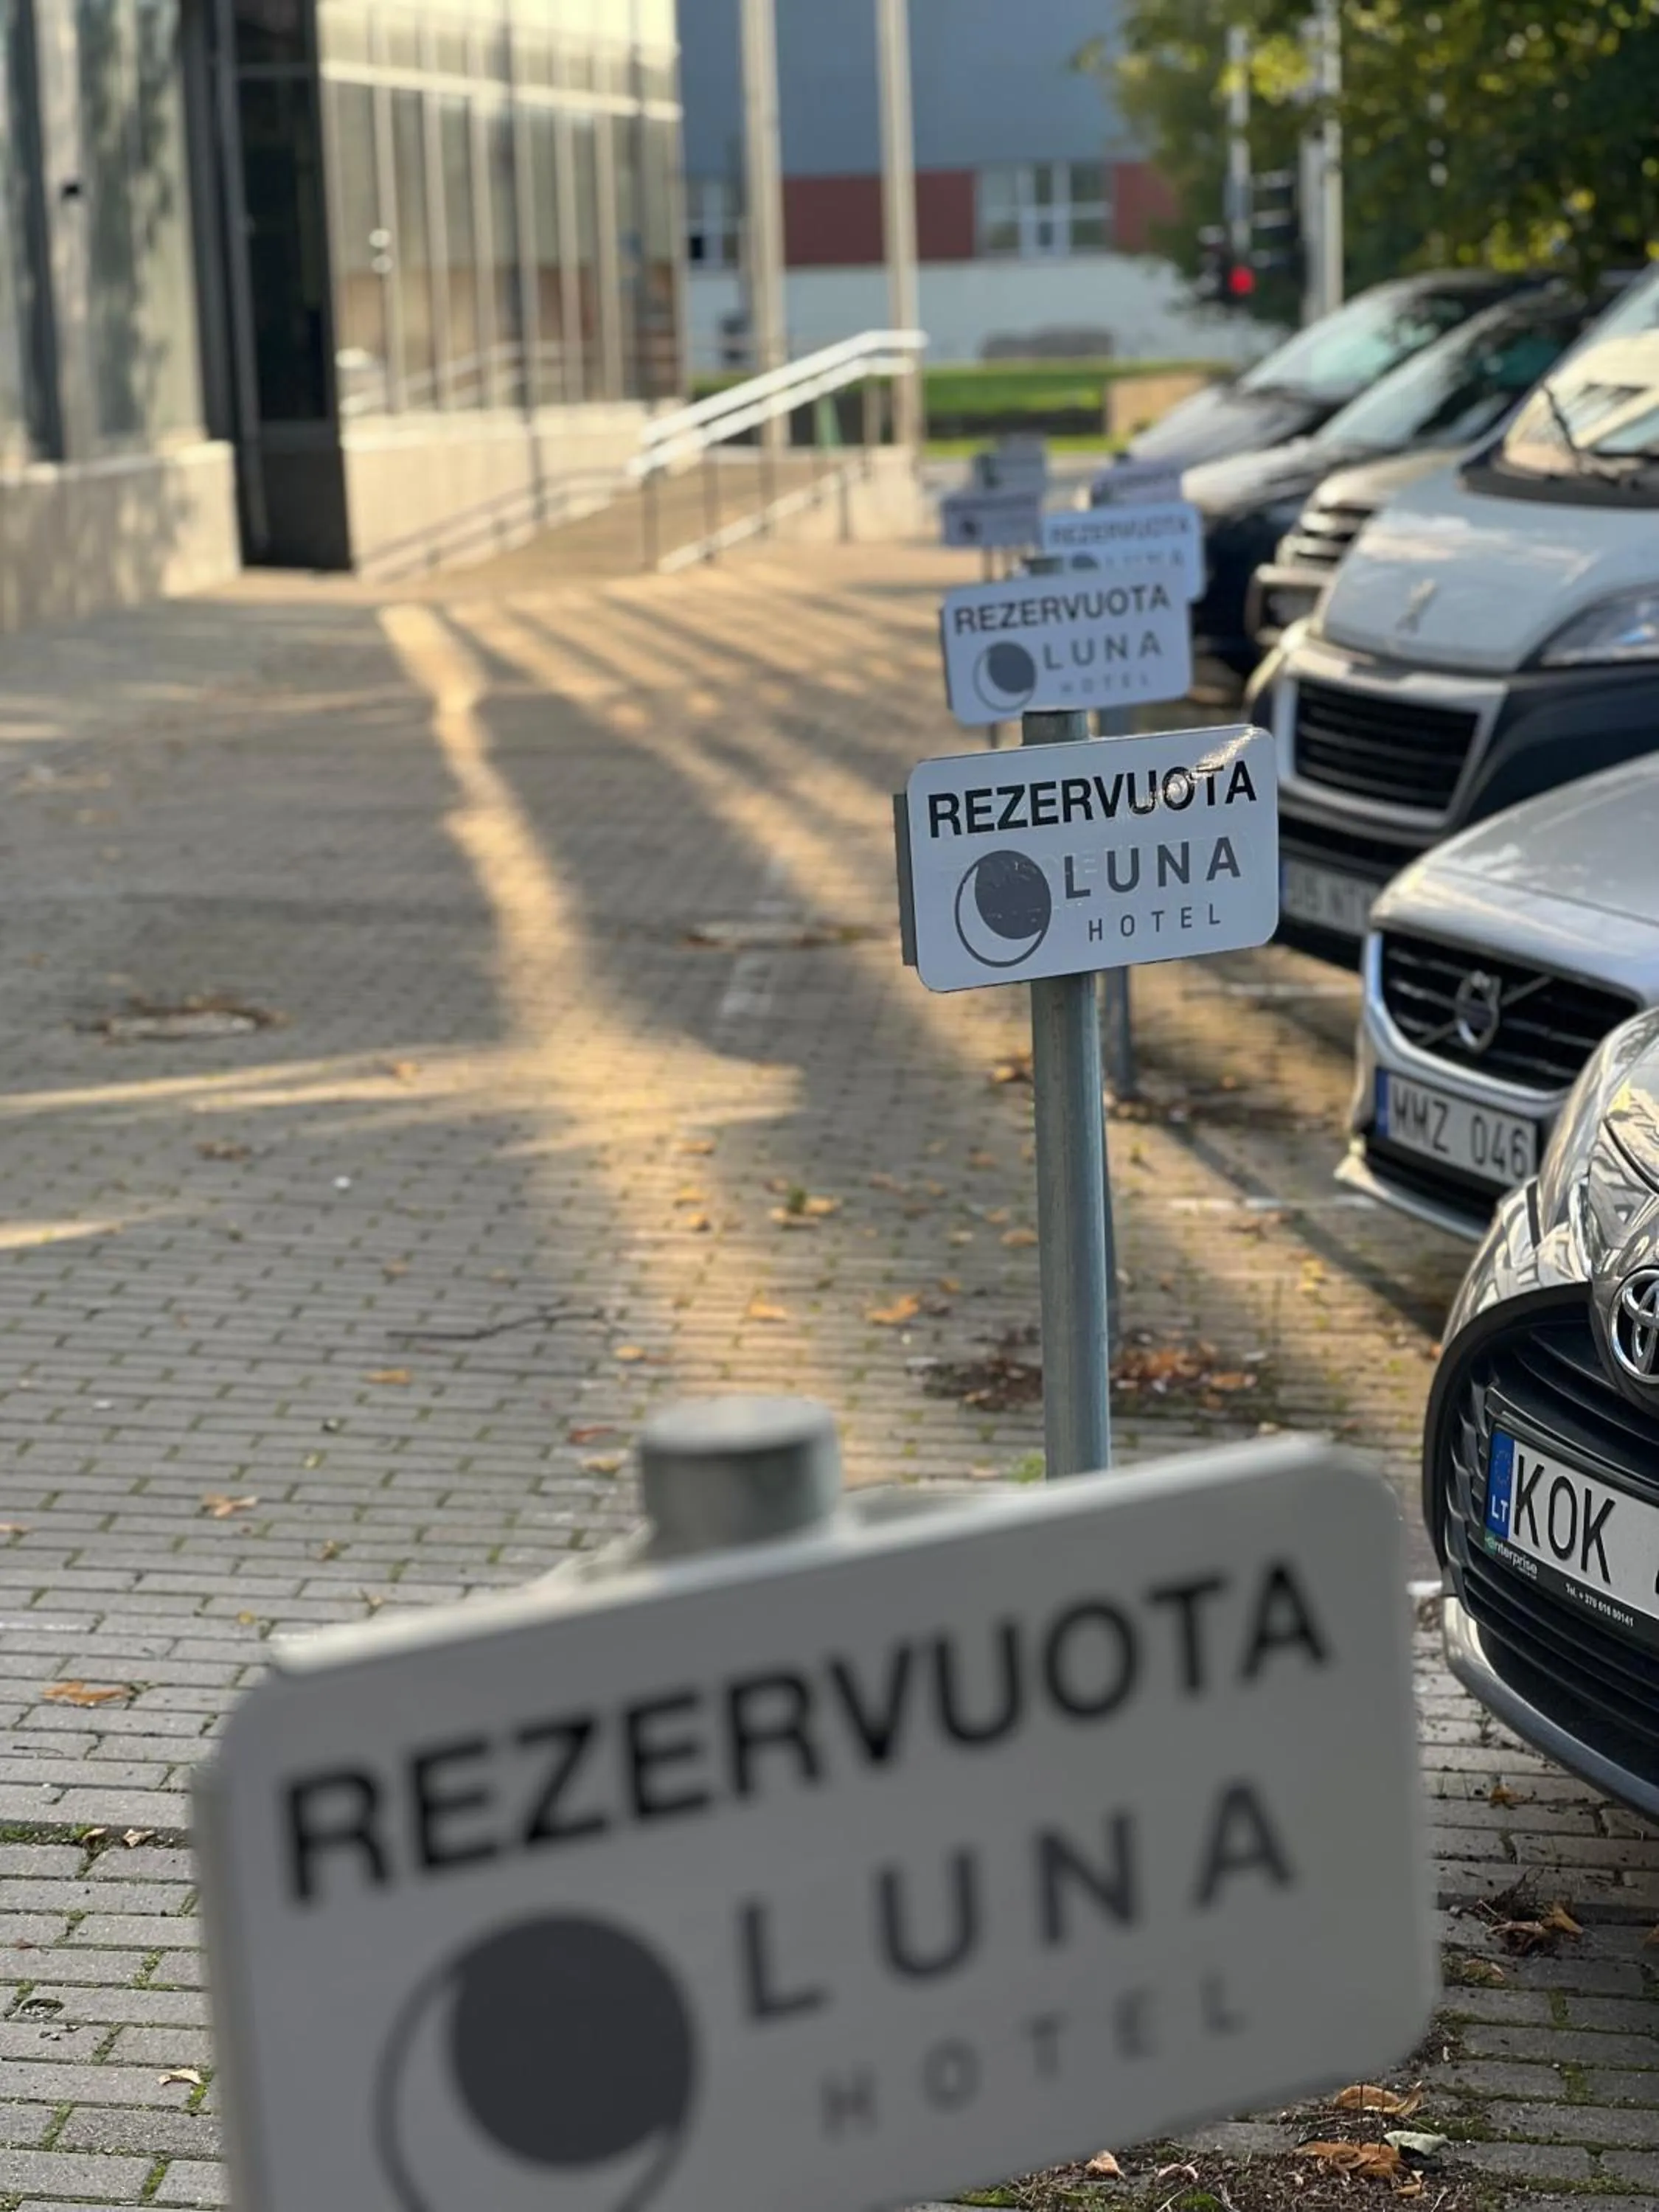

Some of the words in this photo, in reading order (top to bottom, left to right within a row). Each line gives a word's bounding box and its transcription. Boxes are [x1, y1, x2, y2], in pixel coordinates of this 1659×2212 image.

[954, 584, 1171, 636] REZERVUOTA
[1042, 630, 1163, 671] LUNA
[1060, 672, 1152, 695] HOTEL
[927, 760, 1258, 839] REZERVUOTA
[1063, 836, 1242, 900] LUNA
[1088, 902, 1222, 942] HOTEL
[1491, 1495, 1509, 1524] LT
[1514, 1454, 1616, 1585] KOK
[284, 1556, 1333, 1911] REZERVUOTA
[740, 1779, 1301, 2028] LUNA
[820, 1972, 1249, 2142] HOTEL
